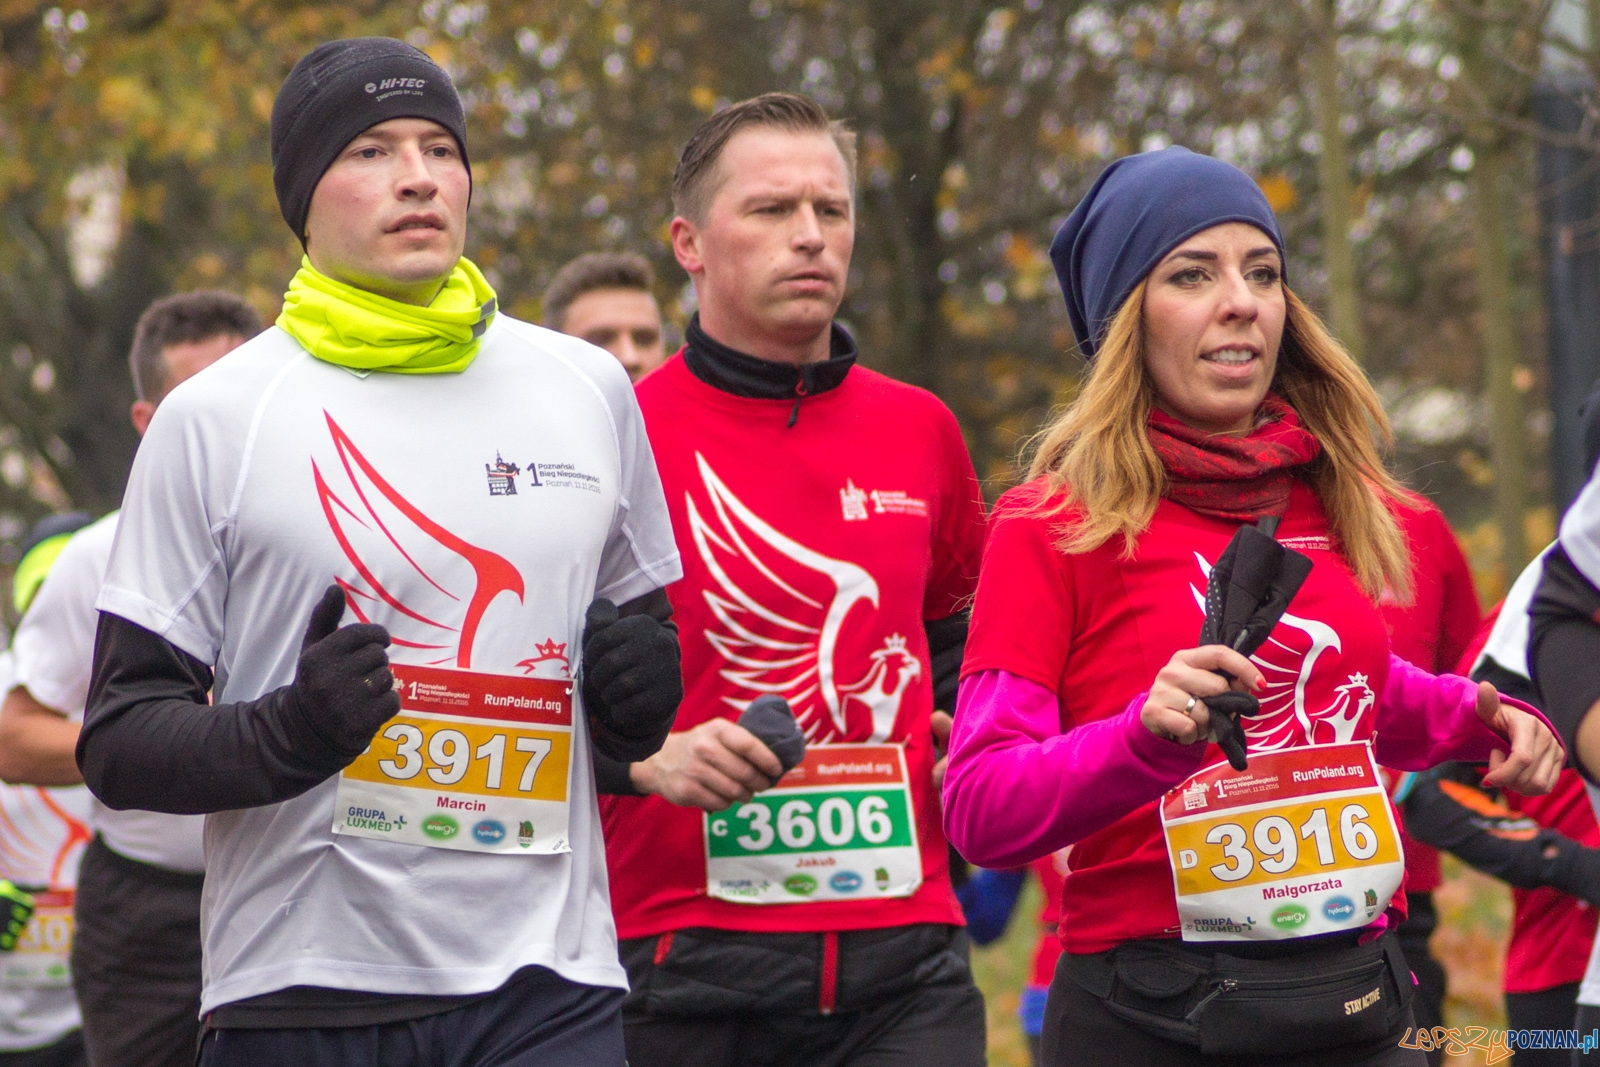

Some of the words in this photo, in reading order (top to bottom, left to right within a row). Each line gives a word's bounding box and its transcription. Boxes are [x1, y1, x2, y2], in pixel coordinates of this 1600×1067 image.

[379, 78, 425, 90] HI-TEC
[527, 463, 543, 487] 1
[538, 462, 575, 471] Poznański
[539, 470, 556, 478] Bieg
[407, 681, 418, 700] 1
[484, 694, 562, 714] RunPoland.org
[378, 723, 552, 792] 3917
[817, 762, 893, 776] RunPoland.org
[1292, 764, 1365, 782] RunPoland.org
[1214, 779, 1228, 799] 1
[436, 796, 487, 812] Marcin
[348, 806, 386, 820] GRUPA
[346, 817, 392, 832] LUXMED
[427, 824, 456, 836] energy
[736, 796, 893, 851] 3606
[1179, 848, 1198, 870] D
[1205, 804, 1379, 882] 3916
[796, 857, 836, 868] Jakub
[1262, 878, 1343, 900] Małgorzata
[1193, 917, 1234, 926] GRUPA
[1277, 912, 1306, 924] energy
[1195, 924, 1242, 933] LUXMED
[1344, 998, 1362, 1016] STAY
[1362, 987, 1381, 1010] ACTIVE
